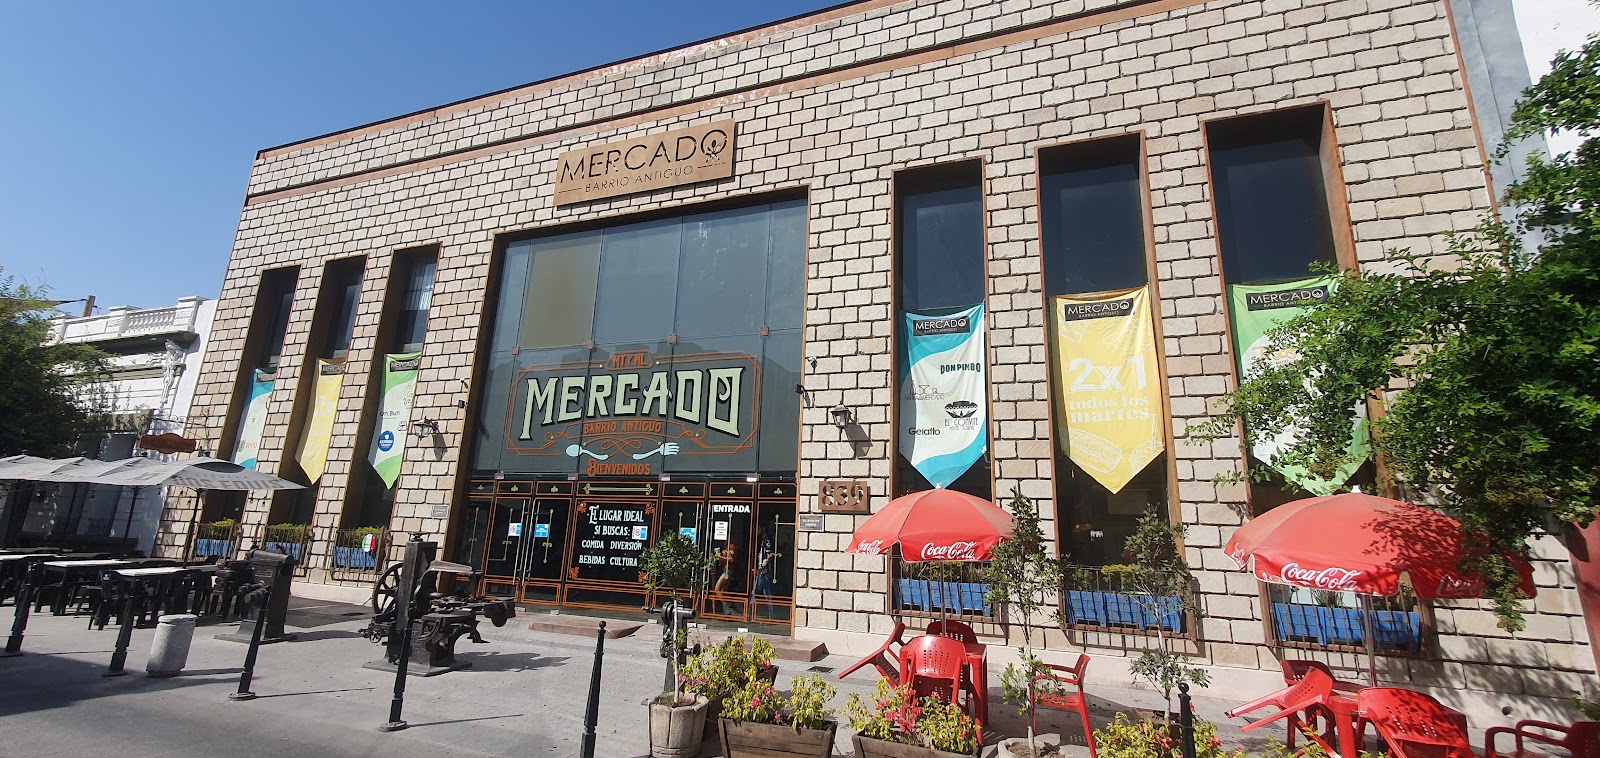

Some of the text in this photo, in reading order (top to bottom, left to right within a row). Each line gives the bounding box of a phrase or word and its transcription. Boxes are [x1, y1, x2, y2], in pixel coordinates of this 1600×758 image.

[560, 130, 728, 183] MERCADO
[585, 165, 694, 192] BARRIO ANTIGUO
[1251, 289, 1324, 304] MERCADO
[1067, 301, 1130, 315] MERCADO
[915, 318, 967, 331] MERCADO
[940, 362, 981, 375] DON PIMBO
[1065, 354, 1147, 393] 2x1
[518, 366, 746, 441] MERCADO
[1069, 394, 1149, 410] todos los
[1070, 408, 1150, 423] martes
[583, 420, 663, 434] BARRIO ANTIGUO
[821, 484, 865, 507] 839
[599, 509, 623, 522] LUGAR
[623, 510, 645, 523] IDEAL
[713, 505, 751, 513] ENTRADA
[602, 525, 631, 536] BUSCAS:
[581, 540, 643, 551] COMIDA DIVERSIÓN
[921, 541, 977, 560] Coca-Cola
[578, 554, 638, 567] BEBIDAS CULTURA
[1281, 562, 1363, 592] Coca-Cola
